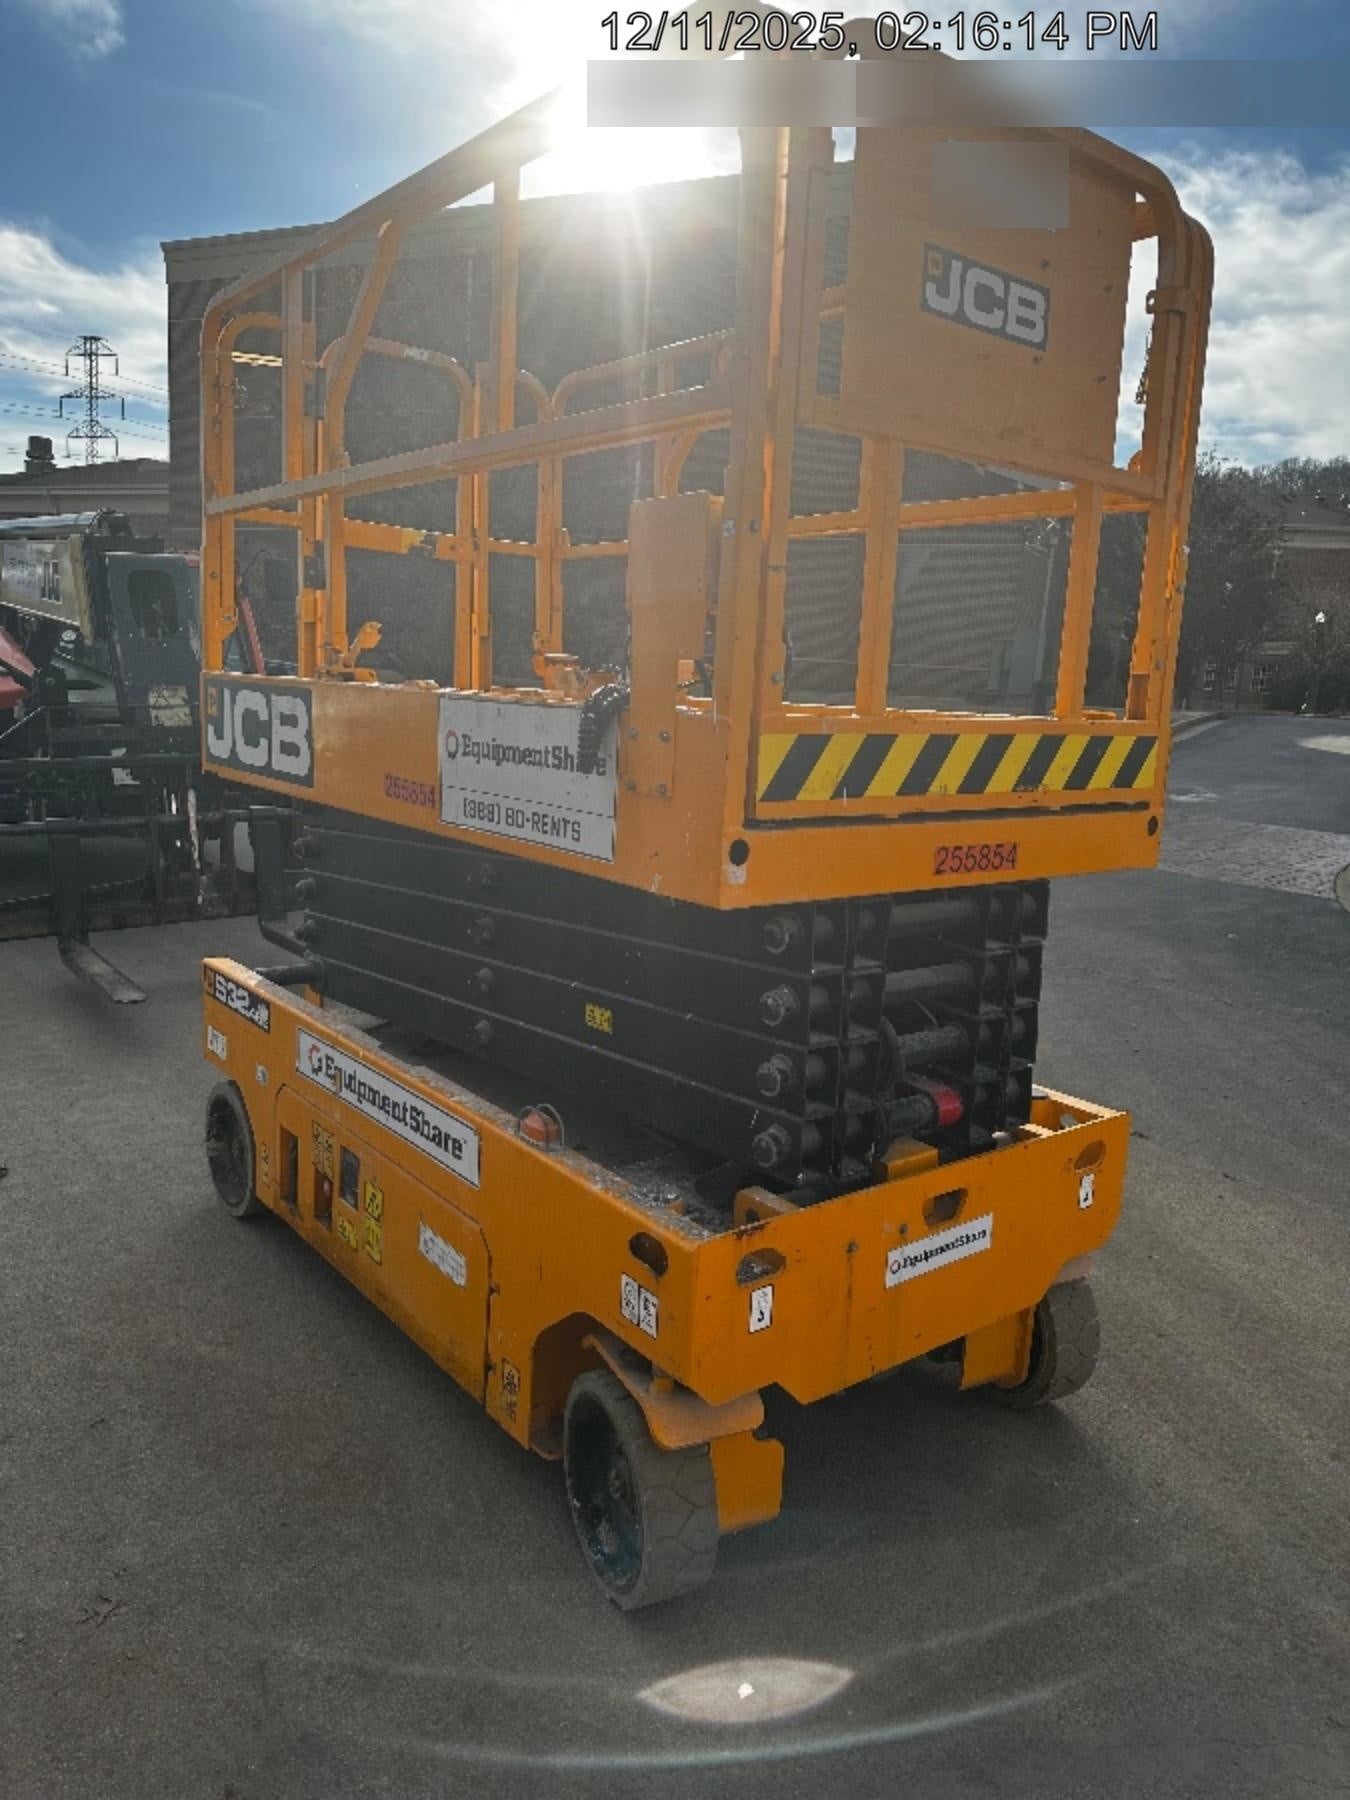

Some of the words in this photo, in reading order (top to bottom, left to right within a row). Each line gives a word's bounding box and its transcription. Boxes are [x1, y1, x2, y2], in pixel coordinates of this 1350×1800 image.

[926, 259, 1046, 342] JCB
[208, 688, 311, 777] JCB
[461, 733, 607, 776] EquipmentShe
[505, 807, 581, 842] 80-RENTS
[935, 842, 1017, 875] 255854
[325, 1055, 464, 1160] EquipmentShare
